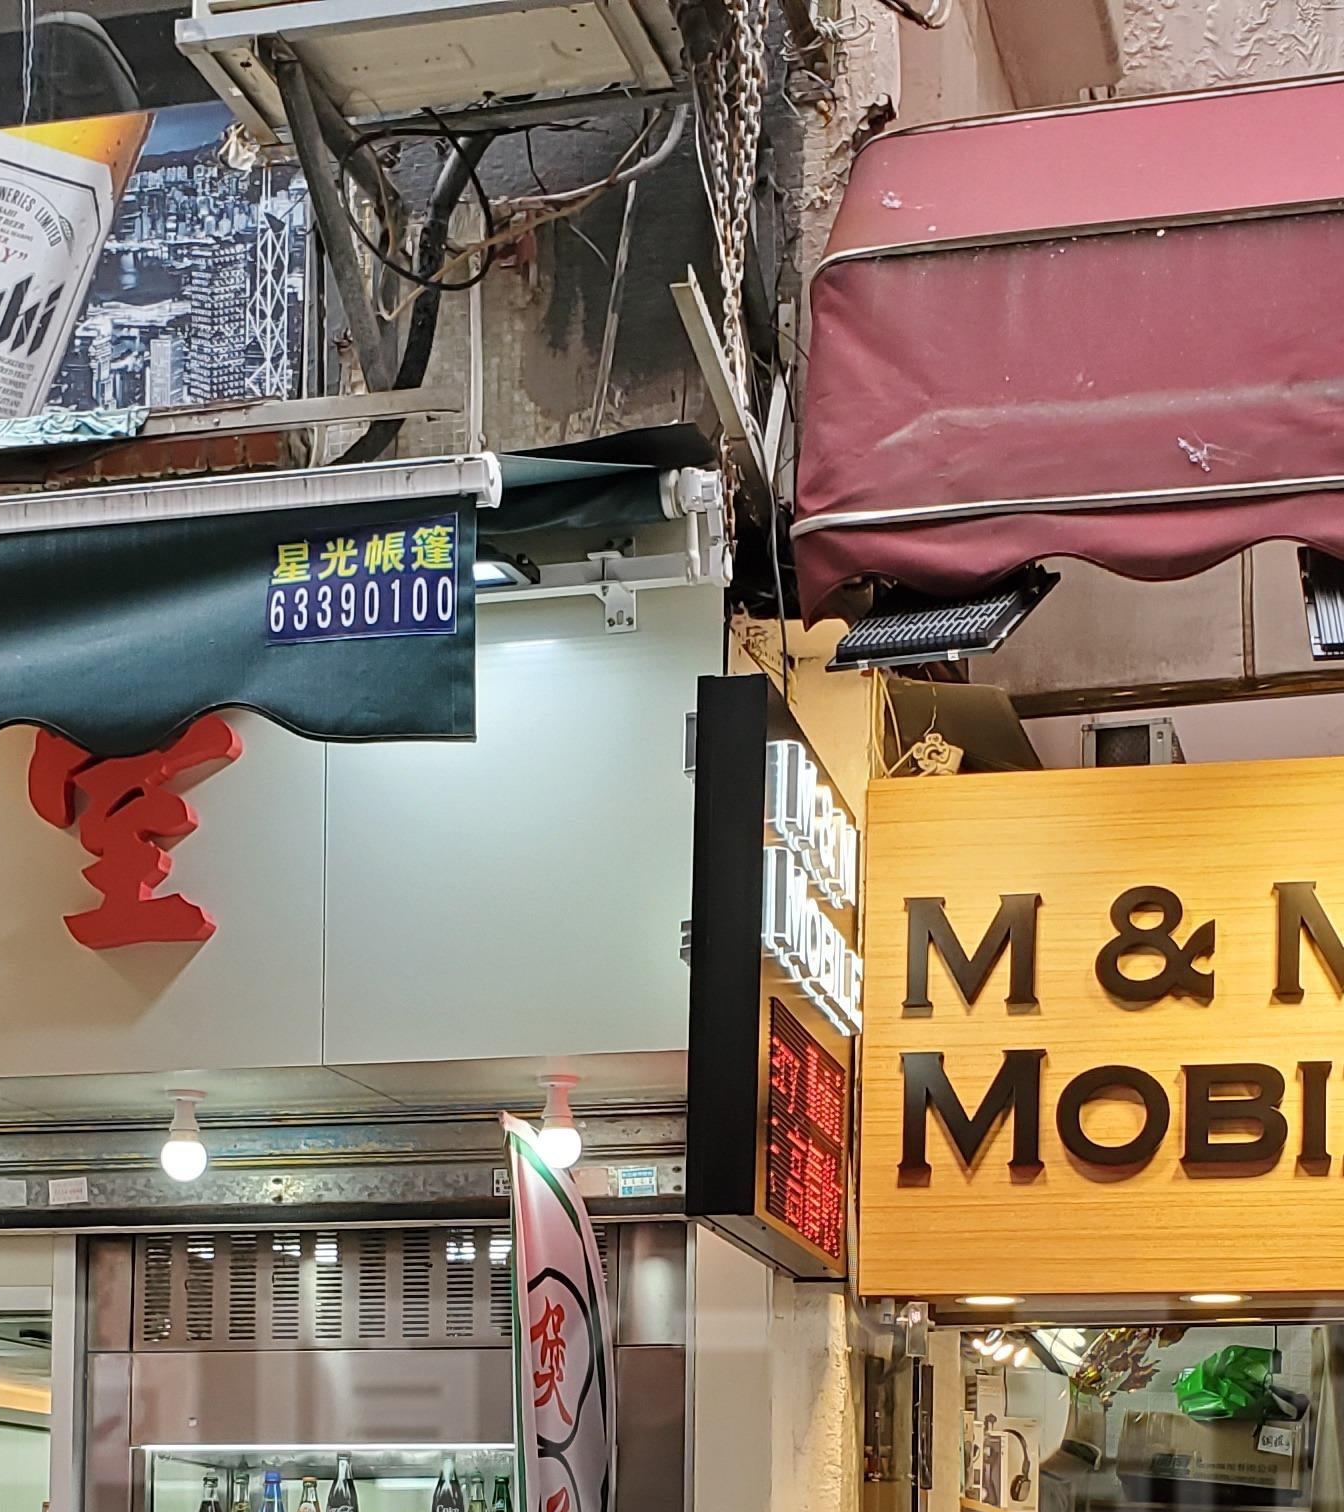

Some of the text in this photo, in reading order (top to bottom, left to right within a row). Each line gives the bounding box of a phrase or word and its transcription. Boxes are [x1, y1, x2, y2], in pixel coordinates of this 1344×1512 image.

[34, 207, 62, 247] LIMITED
[271, 524, 454, 585] 星光帳篷
[270, 576, 453, 632] 63390100
[903, 893, 1042, 1016] M
[1095, 884, 1216, 1006] &
